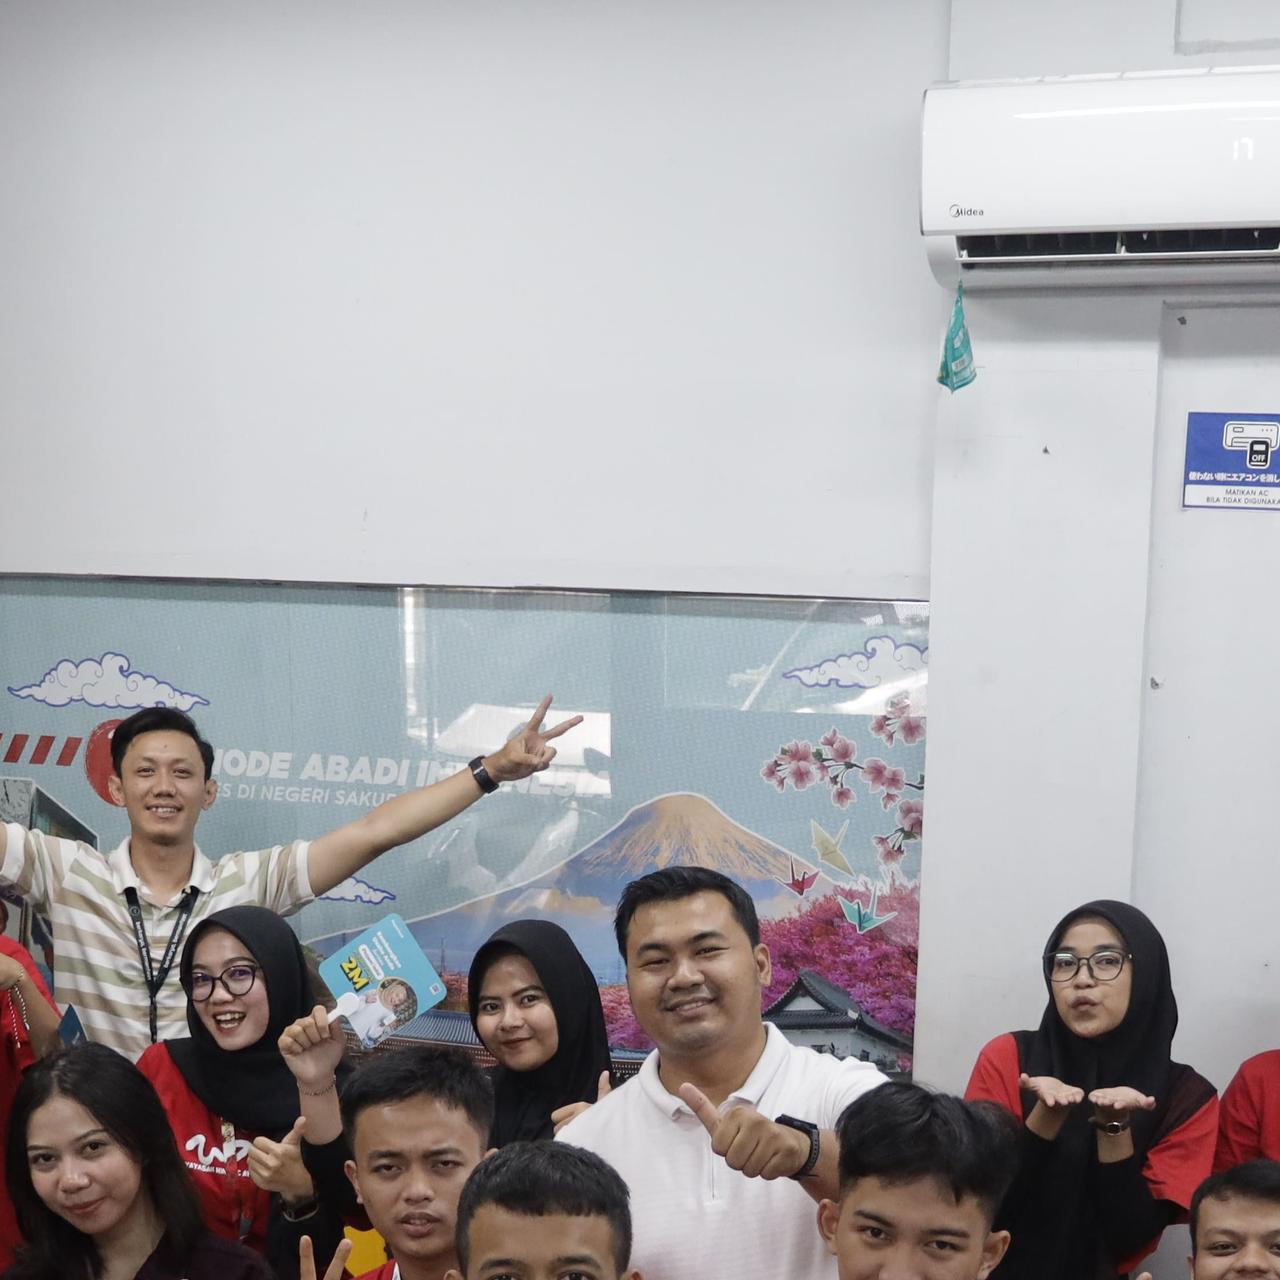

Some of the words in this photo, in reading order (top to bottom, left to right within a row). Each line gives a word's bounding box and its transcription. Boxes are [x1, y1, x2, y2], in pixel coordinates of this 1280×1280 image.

[949, 204, 985, 218] Midea
[1251, 453, 1267, 462] OFF
[1225, 488, 1257, 497] MATIKAN
[1258, 489, 1269, 497] AC
[1206, 496, 1221, 504] BILA
[297, 754, 411, 786] ABADI
[236, 784, 257, 800] DI
[260, 786, 330, 804] NEGERI
[340, 955, 371, 993] 2M
[185, 1161, 214, 1173] YAYASAN
